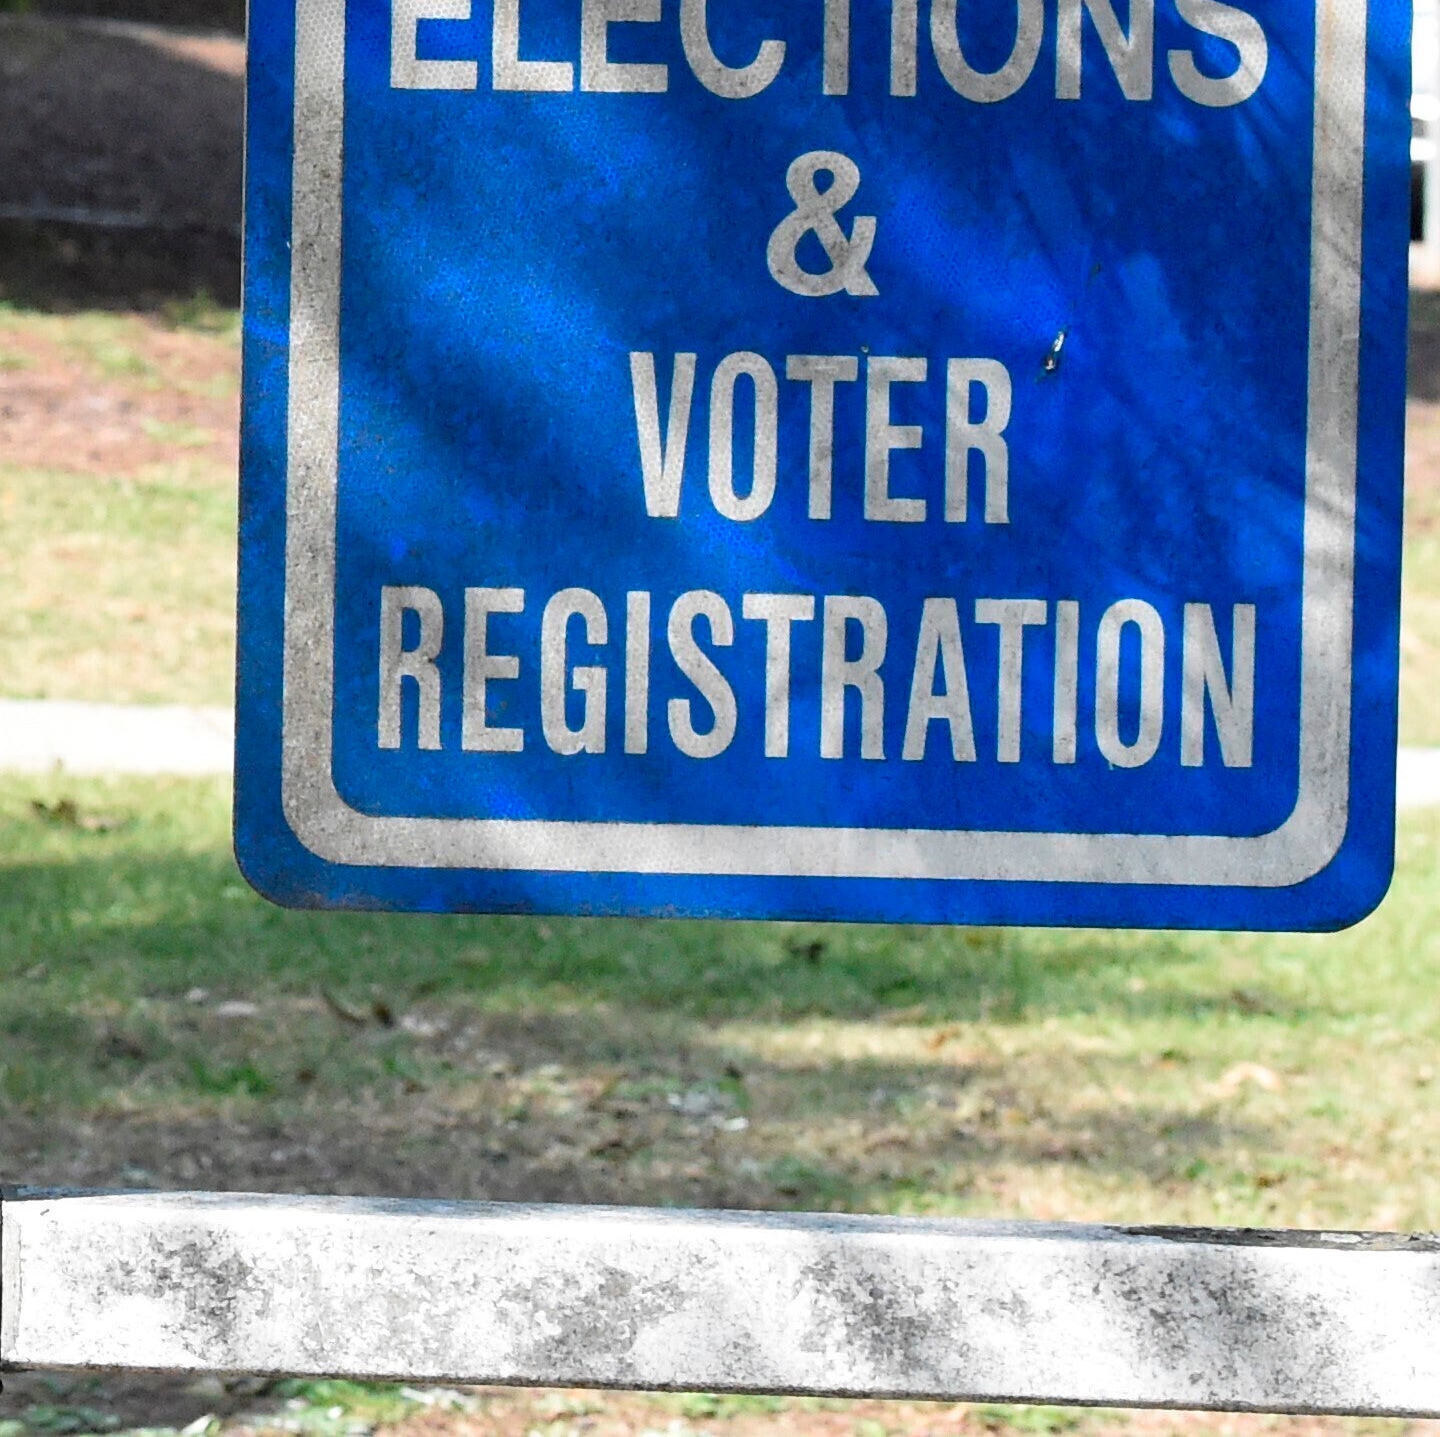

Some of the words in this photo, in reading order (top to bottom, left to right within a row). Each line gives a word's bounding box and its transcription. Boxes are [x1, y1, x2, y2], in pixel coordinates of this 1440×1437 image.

[767, 149, 879, 298] &
[628, 350, 1012, 525] VOTER
[377, 584, 1257, 768] REGISTRATION
